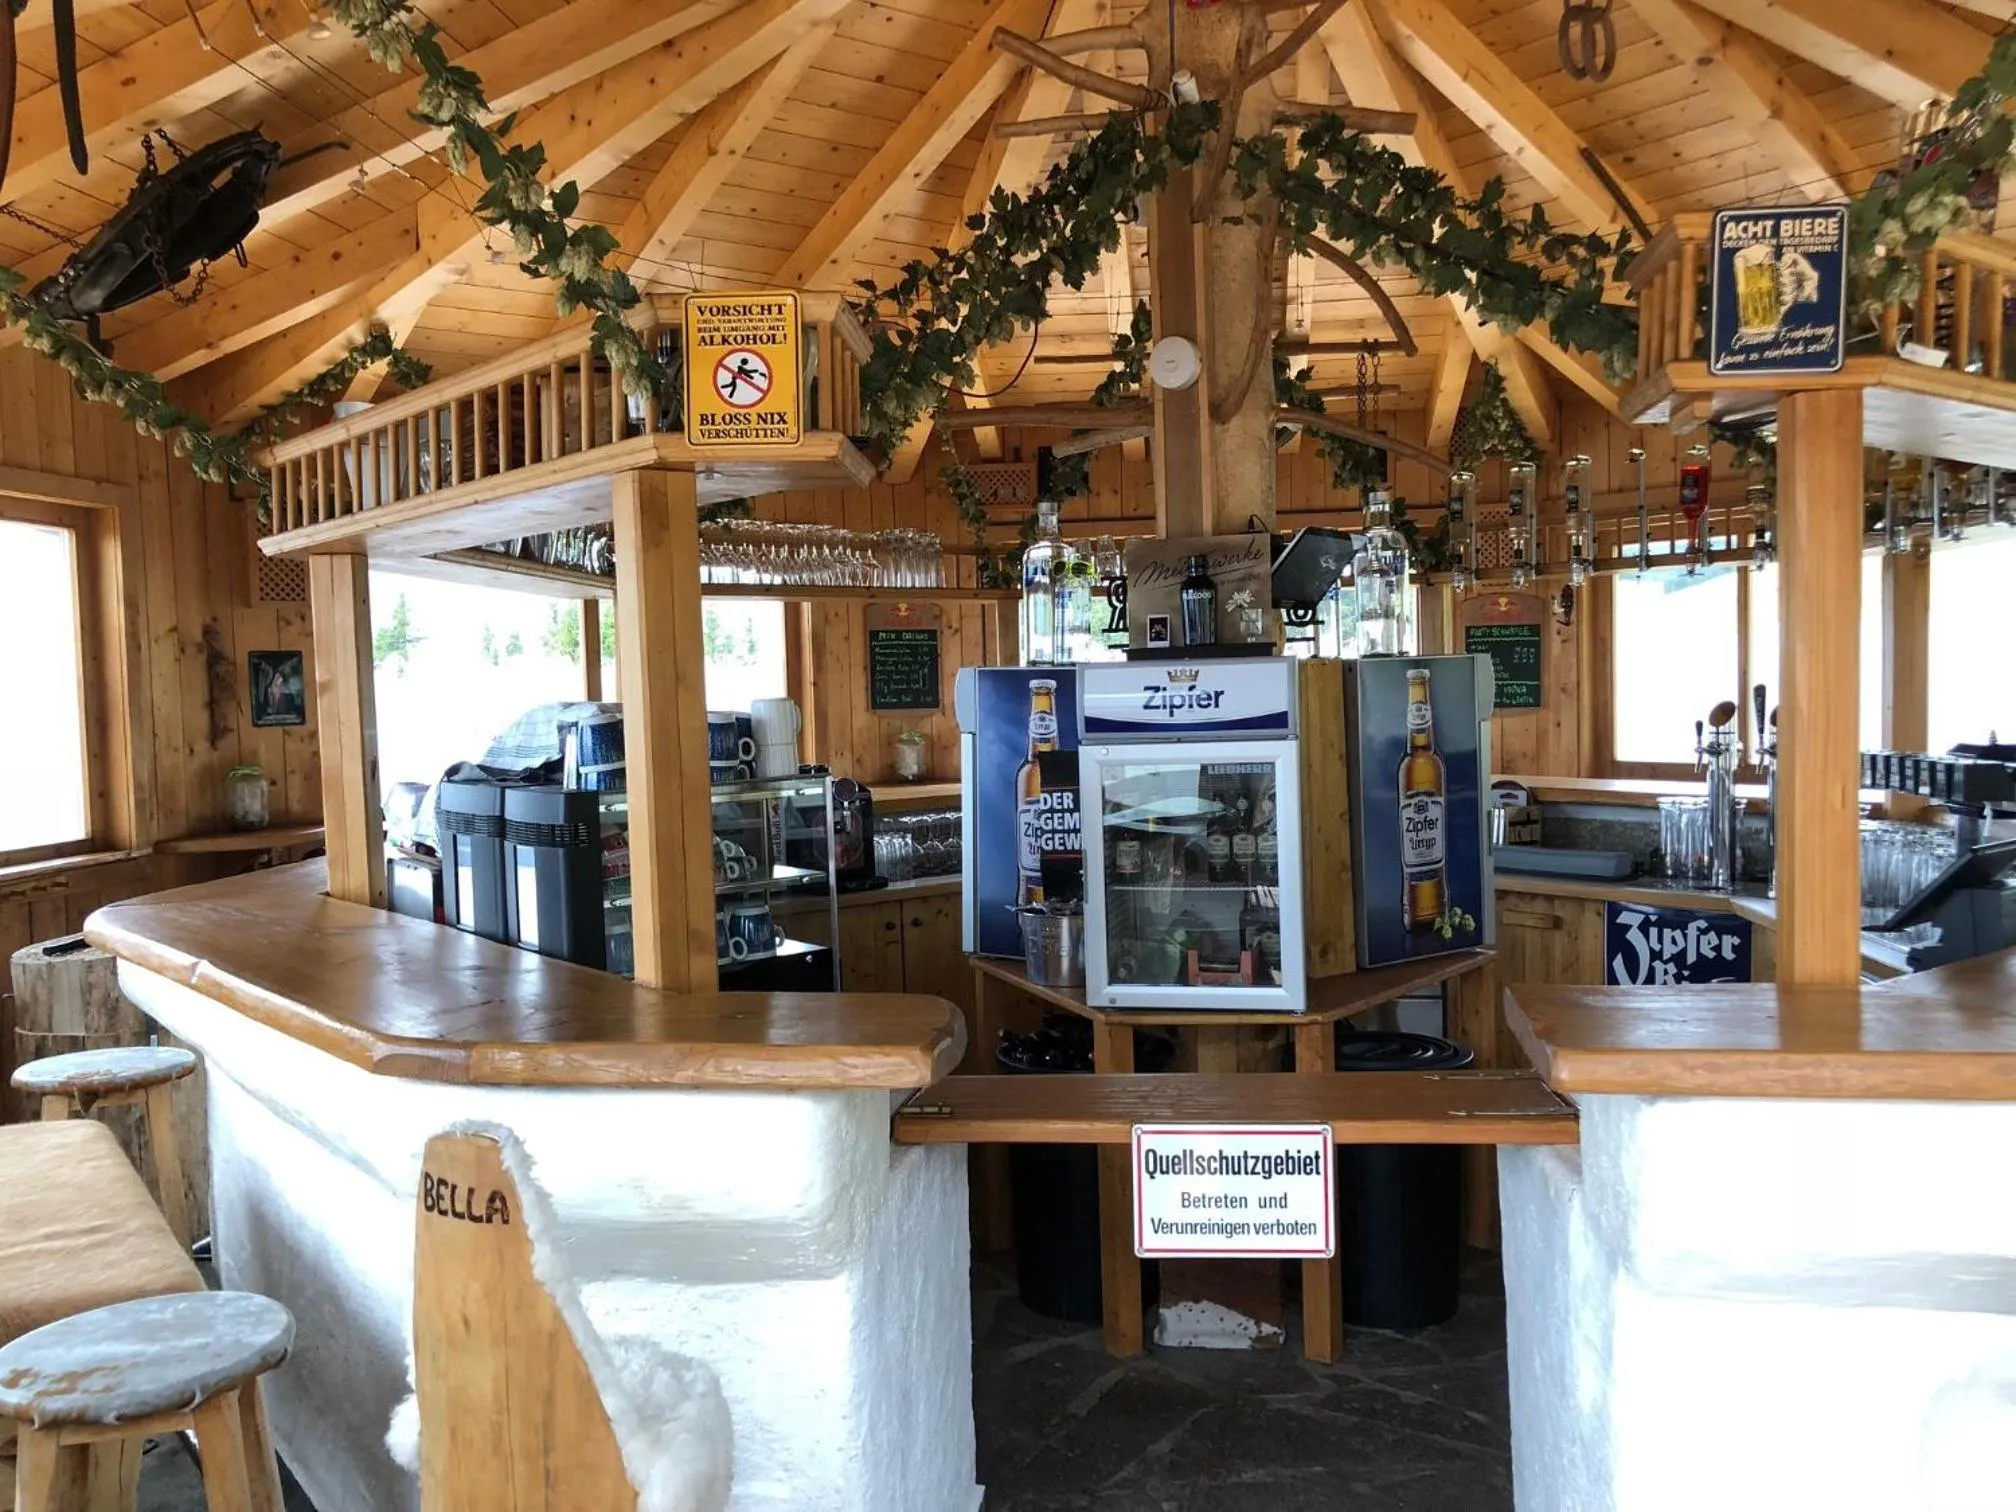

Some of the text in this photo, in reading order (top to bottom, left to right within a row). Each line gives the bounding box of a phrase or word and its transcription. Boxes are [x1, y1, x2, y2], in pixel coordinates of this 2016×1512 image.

[1723, 218, 1839, 240] ACHT BIERE
[697, 303, 787, 317] VORSICHT
[697, 324, 786, 334] BEIM UMGANG MIT
[697, 333, 788, 347] ALKOHOL!
[699, 411, 789, 427] BLOSS NIX
[699, 426, 790, 440] VERSCHÜTTEN!
[1142, 684, 1225, 717] Zipfer
[1041, 792, 1074, 809] DER
[1405, 816, 1439, 838] Zipfer
[1612, 910, 1742, 985] Zipfer
[1144, 1148, 1321, 1180] Quellschutzgebiet
[423, 1171, 511, 1225] BELLA
[1181, 1191, 1288, 1209] Betreten und
[1150, 1217, 1317, 1239] Verunreinigen verboten
